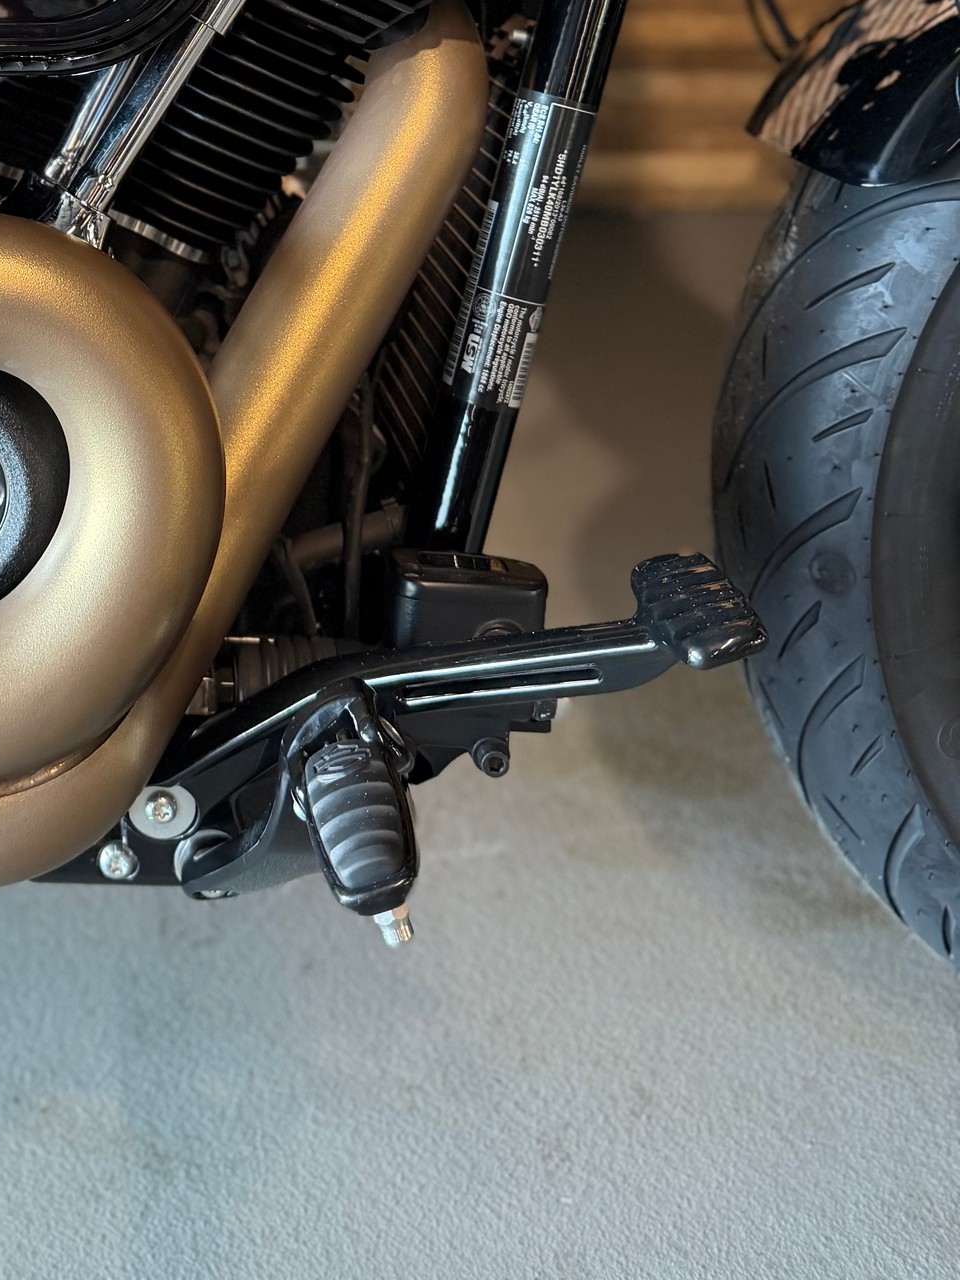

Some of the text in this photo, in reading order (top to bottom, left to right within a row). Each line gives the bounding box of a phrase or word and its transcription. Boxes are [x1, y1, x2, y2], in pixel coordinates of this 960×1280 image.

[495, 300, 506, 323] Engine
[518, 306, 526, 319] The
[495, 318, 509, 354] motorcycle
[495, 304, 520, 384] conforms to all applicable
[509, 319, 522, 354] motorcycle
[502, 358, 513, 378] motor
